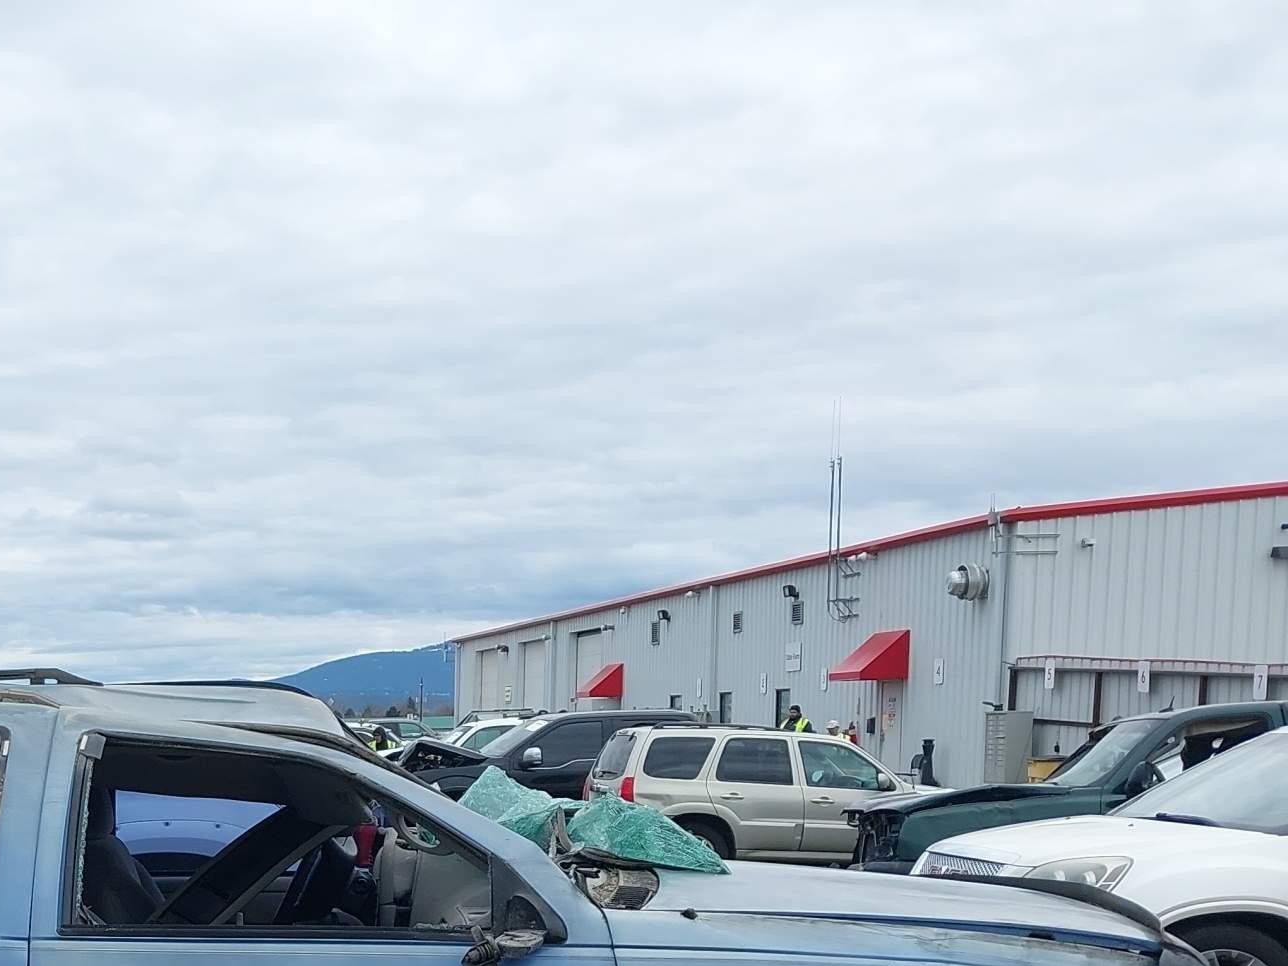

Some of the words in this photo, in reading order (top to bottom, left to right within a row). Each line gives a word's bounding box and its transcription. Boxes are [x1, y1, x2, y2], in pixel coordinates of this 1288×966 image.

[1047, 668, 1053, 680] 5
[1141, 671, 1146, 684] 6
[1257, 674, 1263, 688] 7
